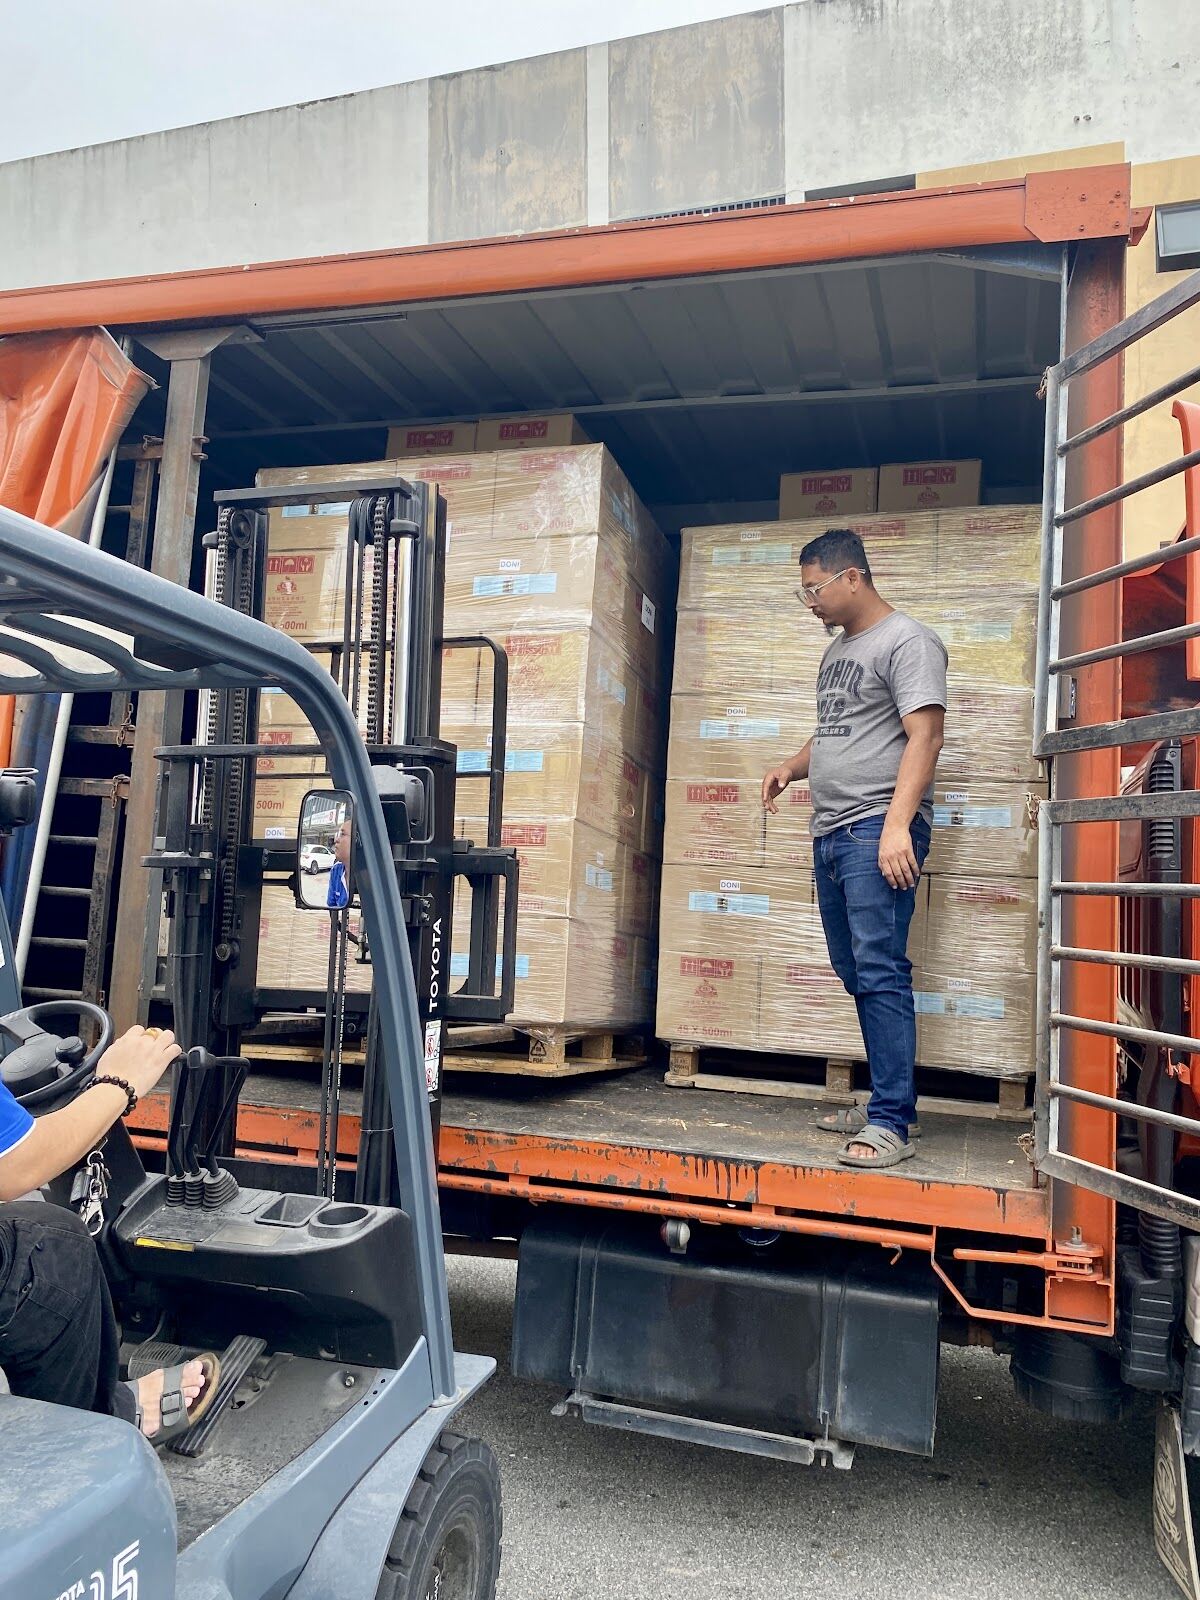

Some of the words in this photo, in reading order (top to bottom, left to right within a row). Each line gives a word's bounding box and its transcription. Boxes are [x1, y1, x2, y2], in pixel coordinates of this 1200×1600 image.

[819, 727, 846, 735] TIGERS
[256, 800, 284, 810] 500ml
[266, 829, 284, 837] DON
[720, 881, 740, 889] DONI
[428, 917, 443, 1013] TOYOTA
[55, 1578, 86, 1600] OTA
